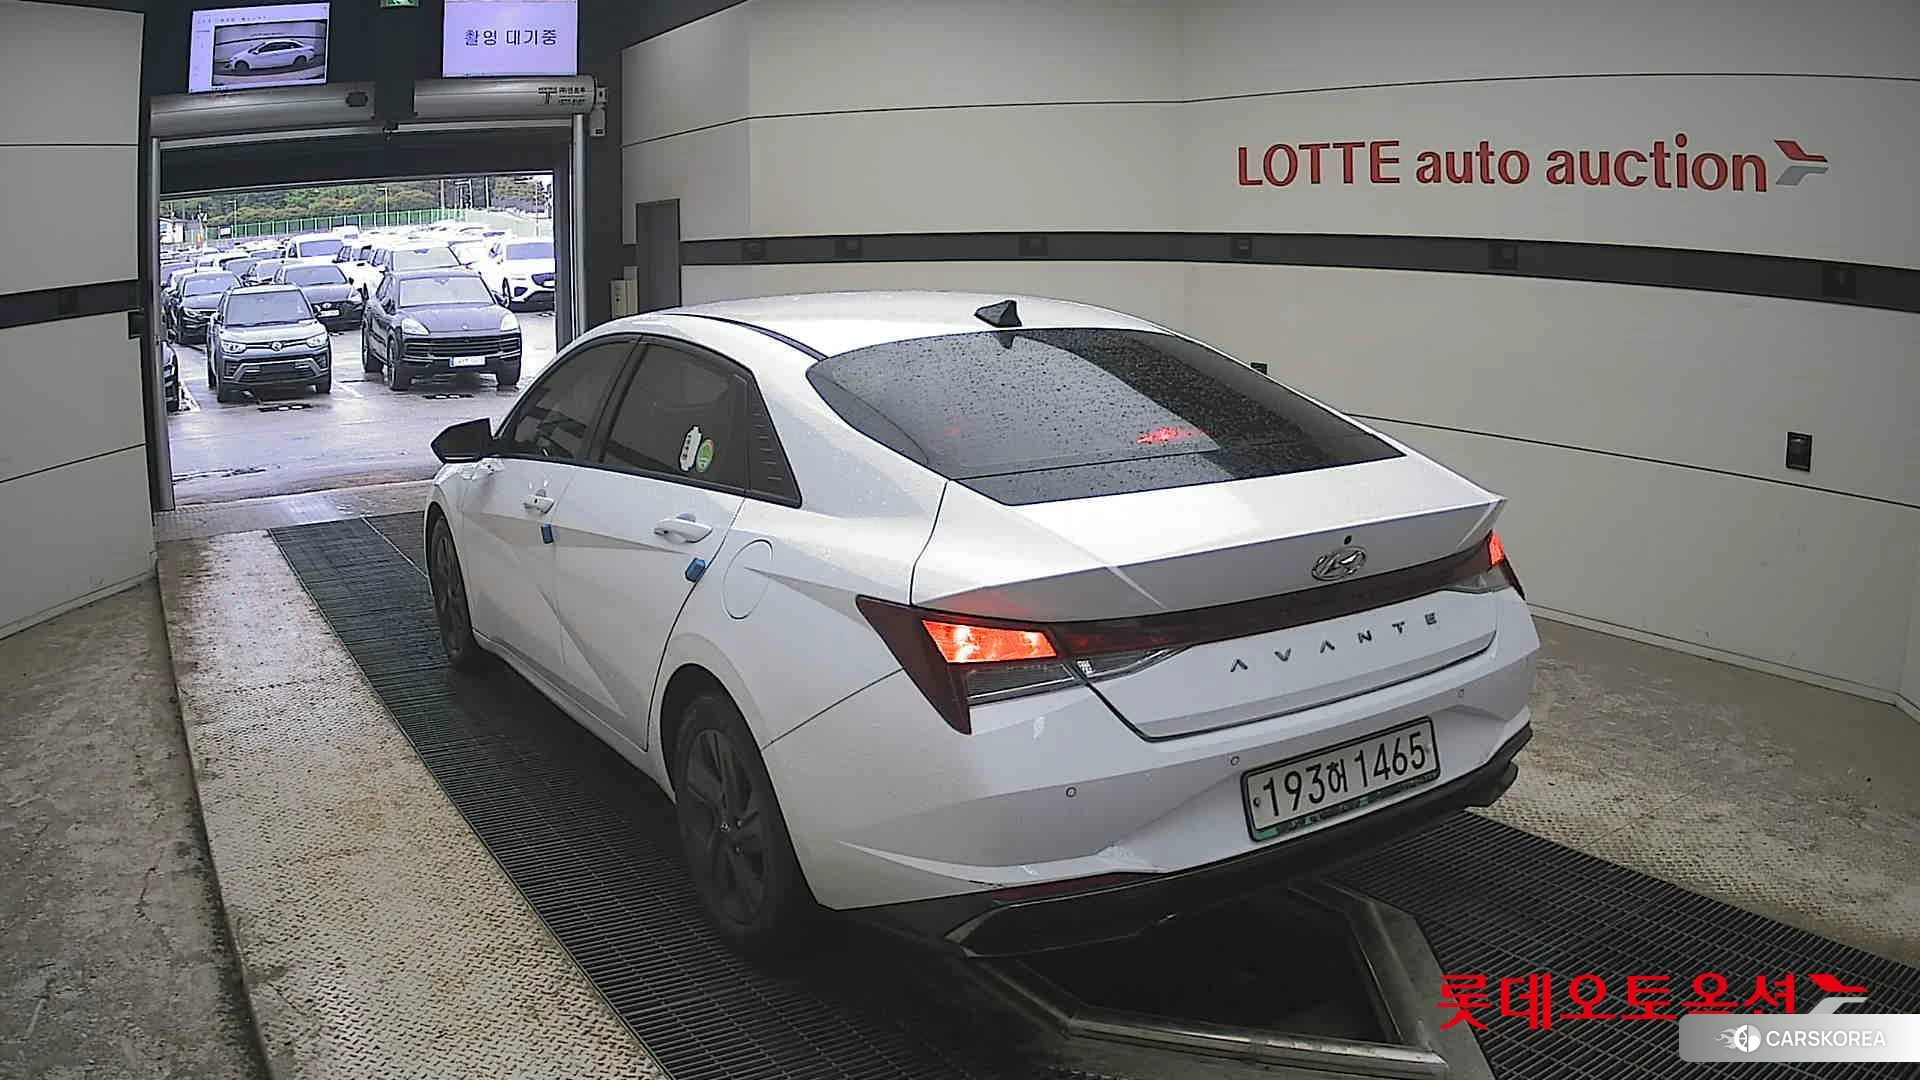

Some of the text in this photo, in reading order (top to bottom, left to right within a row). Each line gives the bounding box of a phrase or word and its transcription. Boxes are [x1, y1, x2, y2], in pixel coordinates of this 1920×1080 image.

[506, 29, 557, 46] 대기중
[1238, 133, 1768, 193] LOTTE auto auction
[1230, 611, 1438, 673] AVANTE
[1263, 731, 1426, 817] 193허 1465
